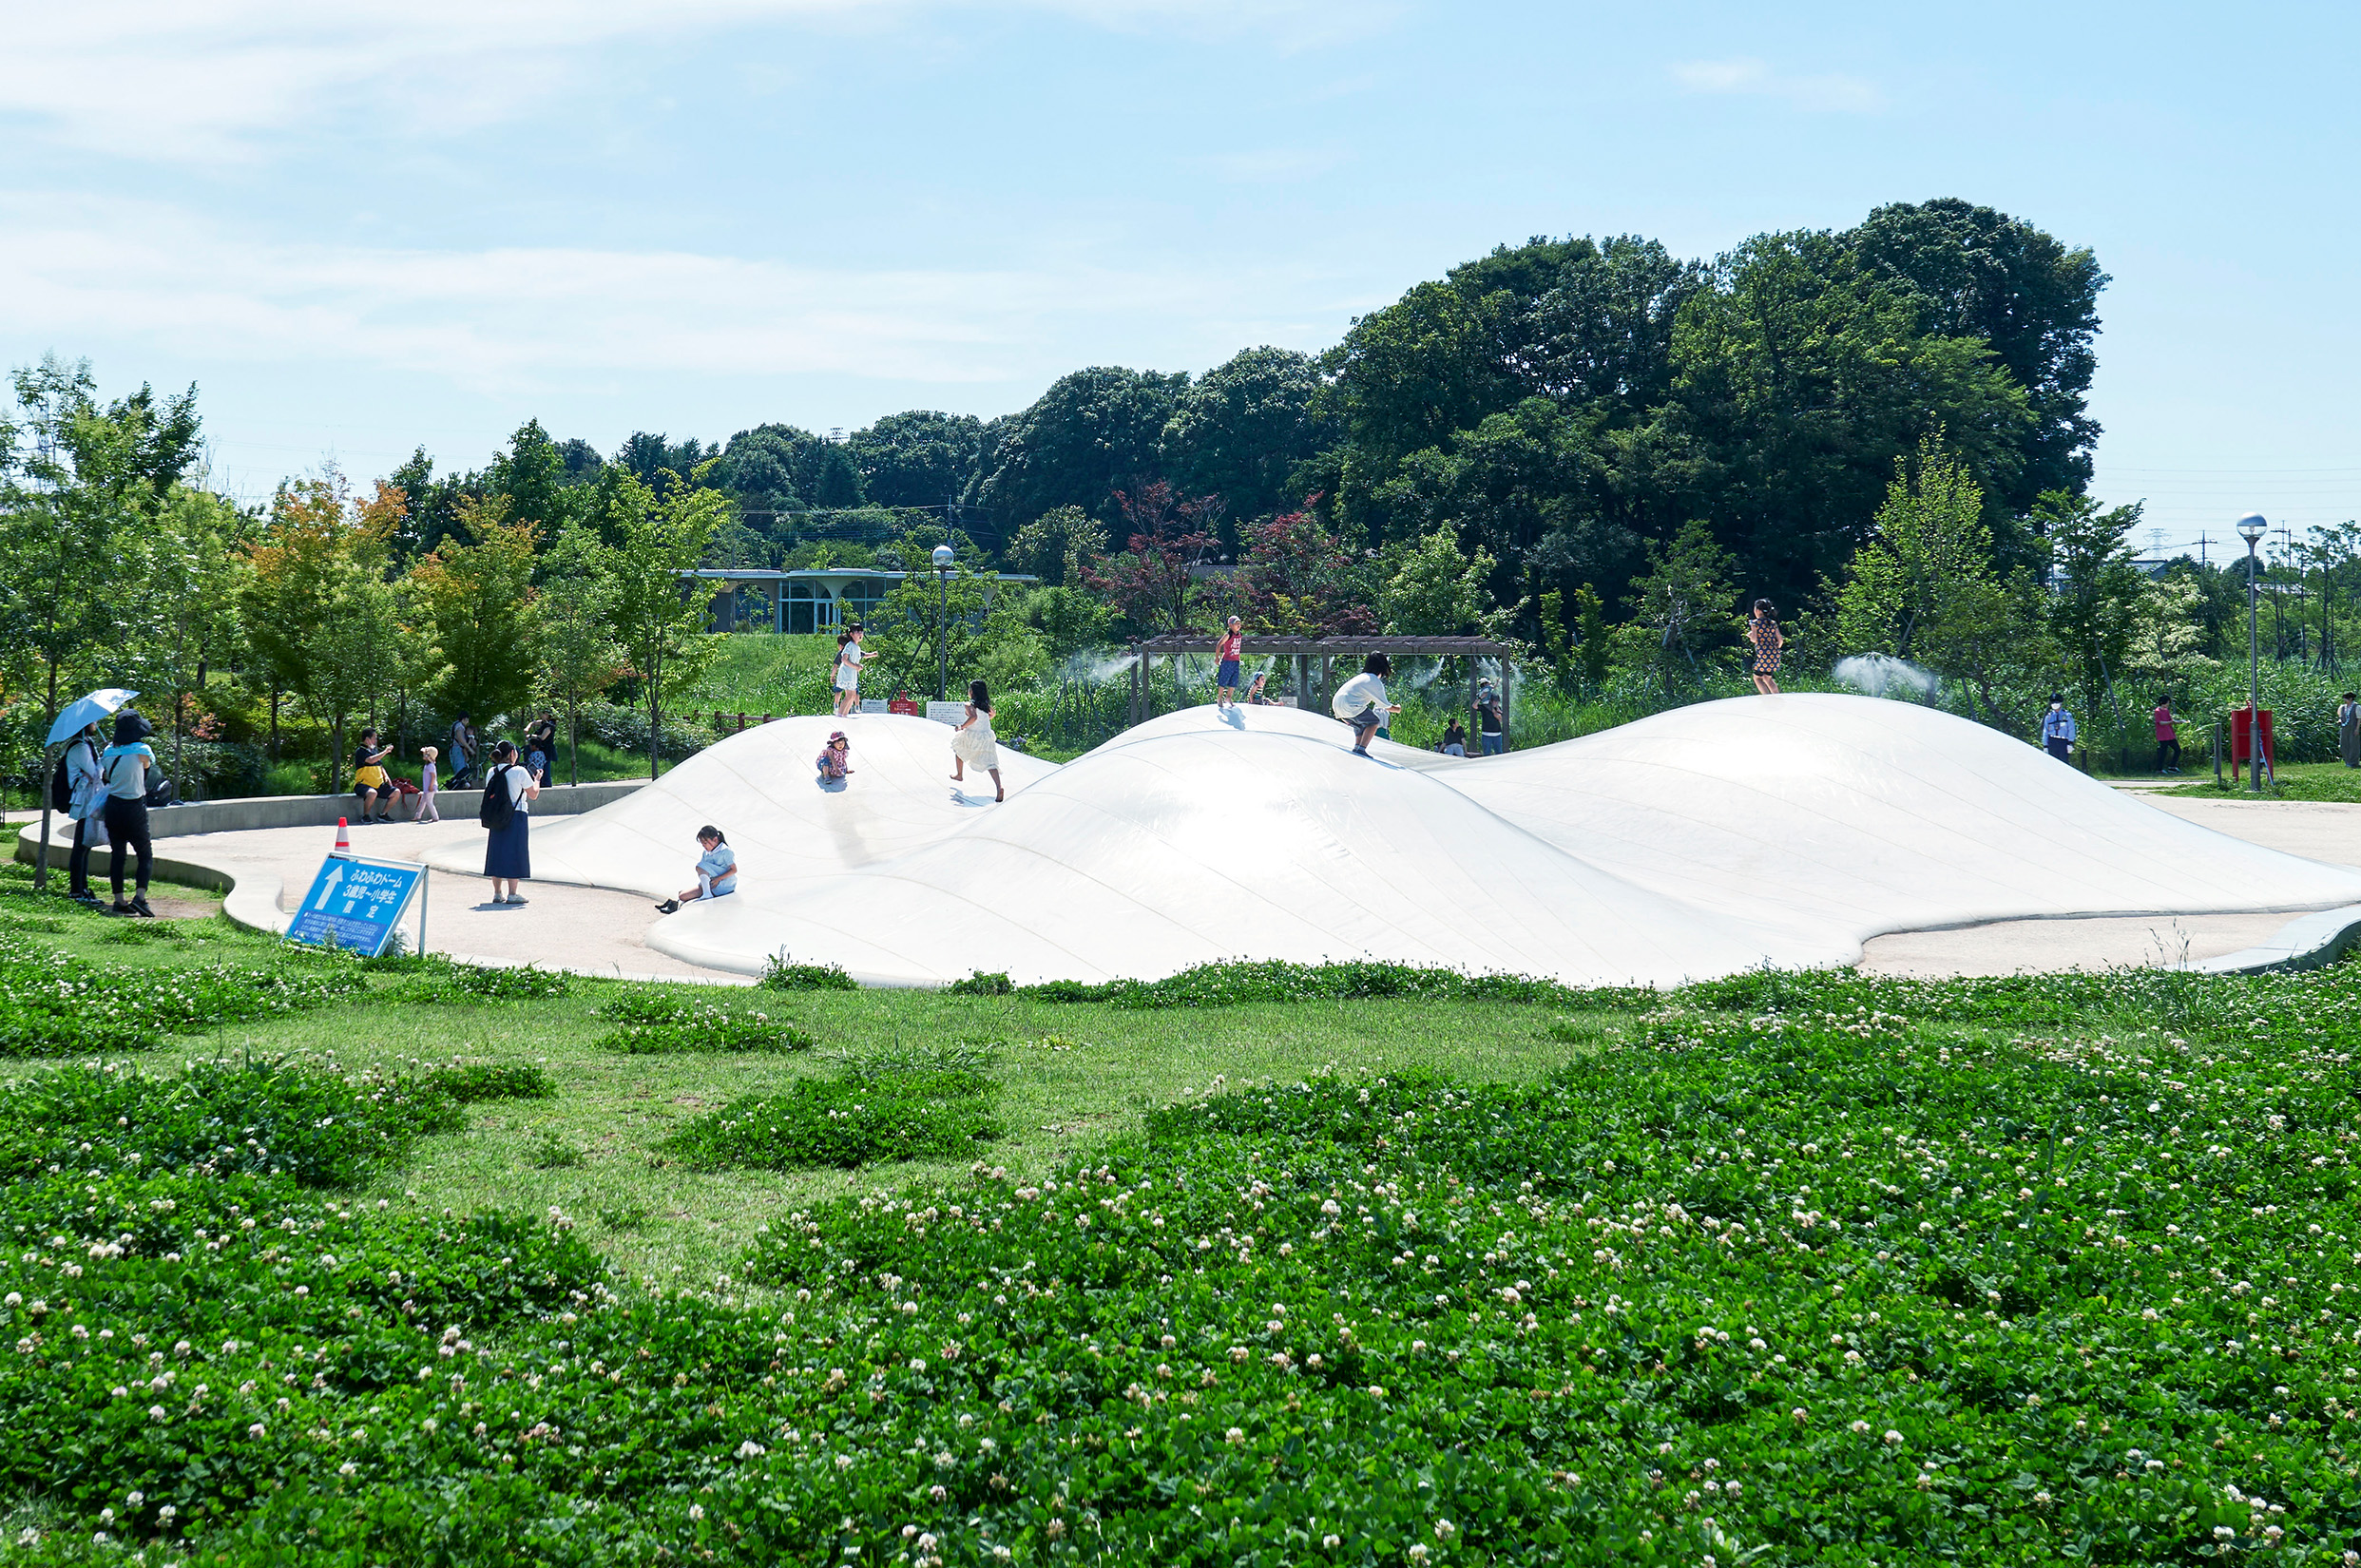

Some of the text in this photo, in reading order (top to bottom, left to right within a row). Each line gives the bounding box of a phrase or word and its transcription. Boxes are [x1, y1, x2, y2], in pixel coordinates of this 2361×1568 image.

[350, 869, 403, 889] ふわふわドーム
